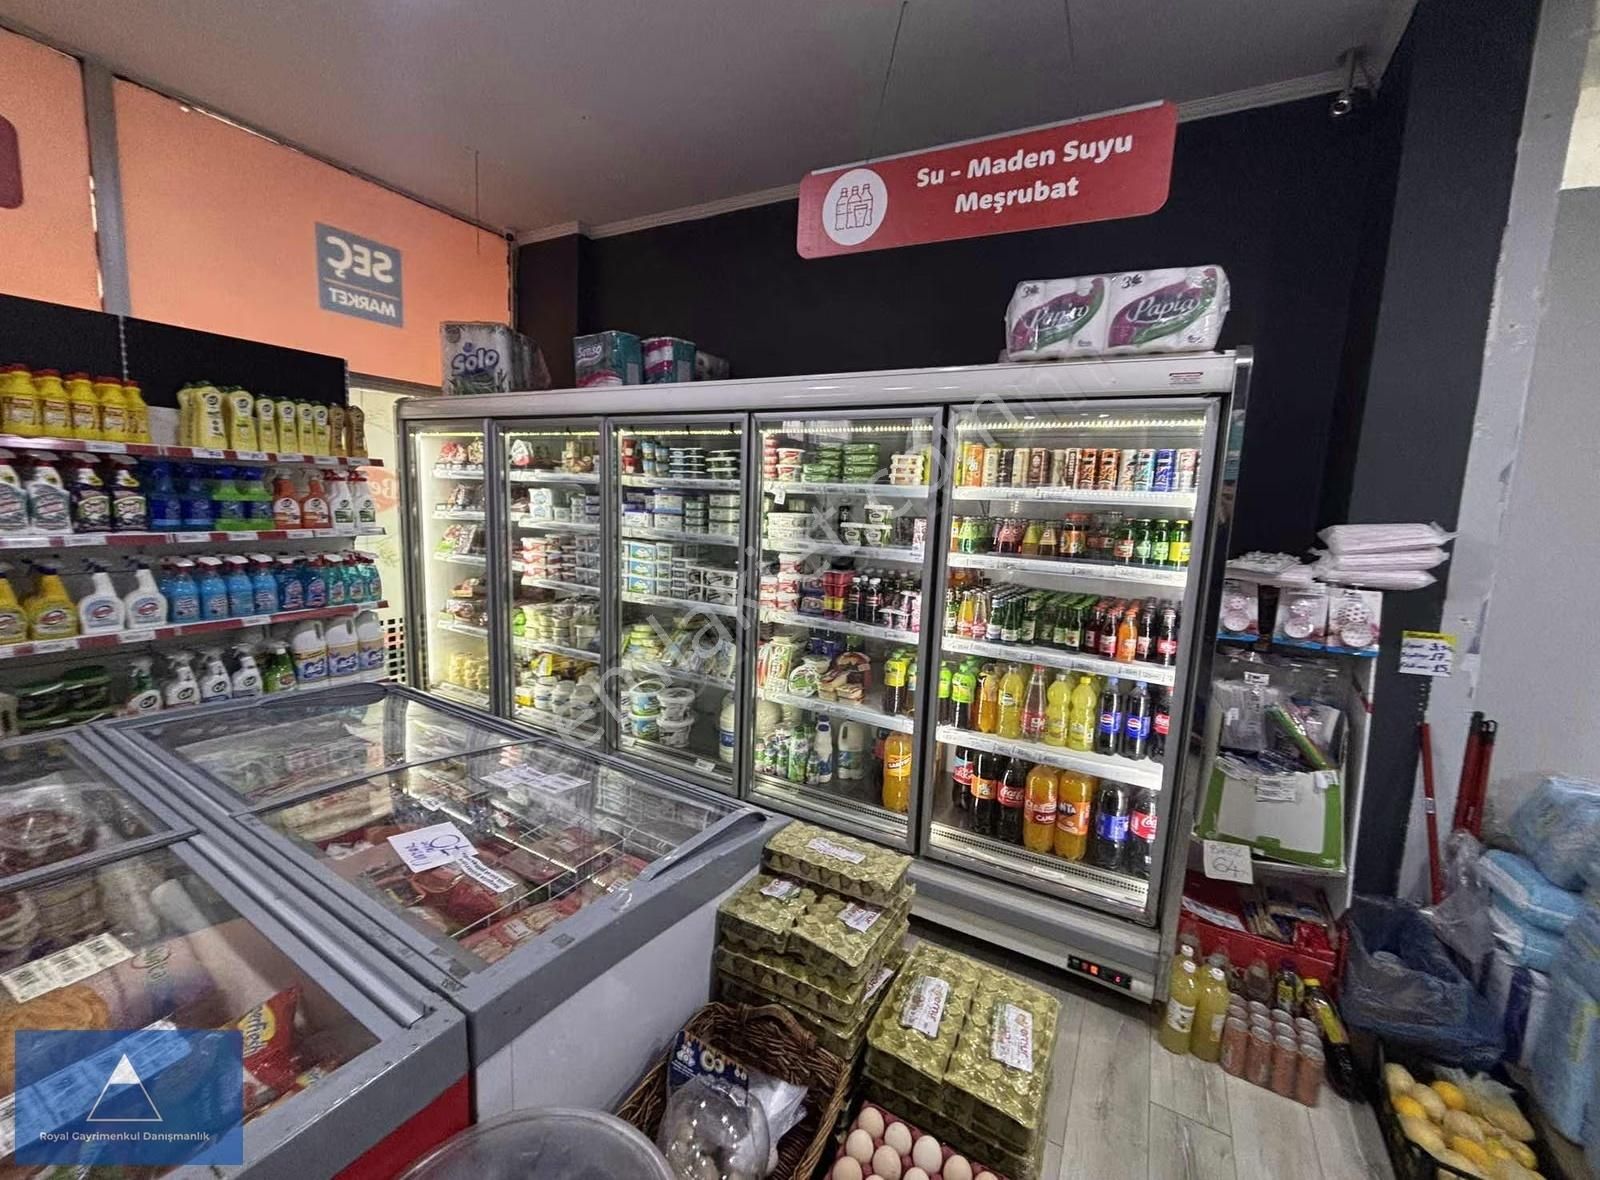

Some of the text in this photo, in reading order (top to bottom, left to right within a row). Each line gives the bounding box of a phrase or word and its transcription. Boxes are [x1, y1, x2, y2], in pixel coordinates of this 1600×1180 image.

[916, 165, 944, 187] Su
[966, 148, 1055, 179] Maden
[1062, 132, 1134, 165] Suyu
[954, 176, 1079, 214] Meşrubat
[1028, 303, 1087, 329] Papia
[1133, 294, 1196, 321] Papia
[452, 347, 500, 375] Solo
